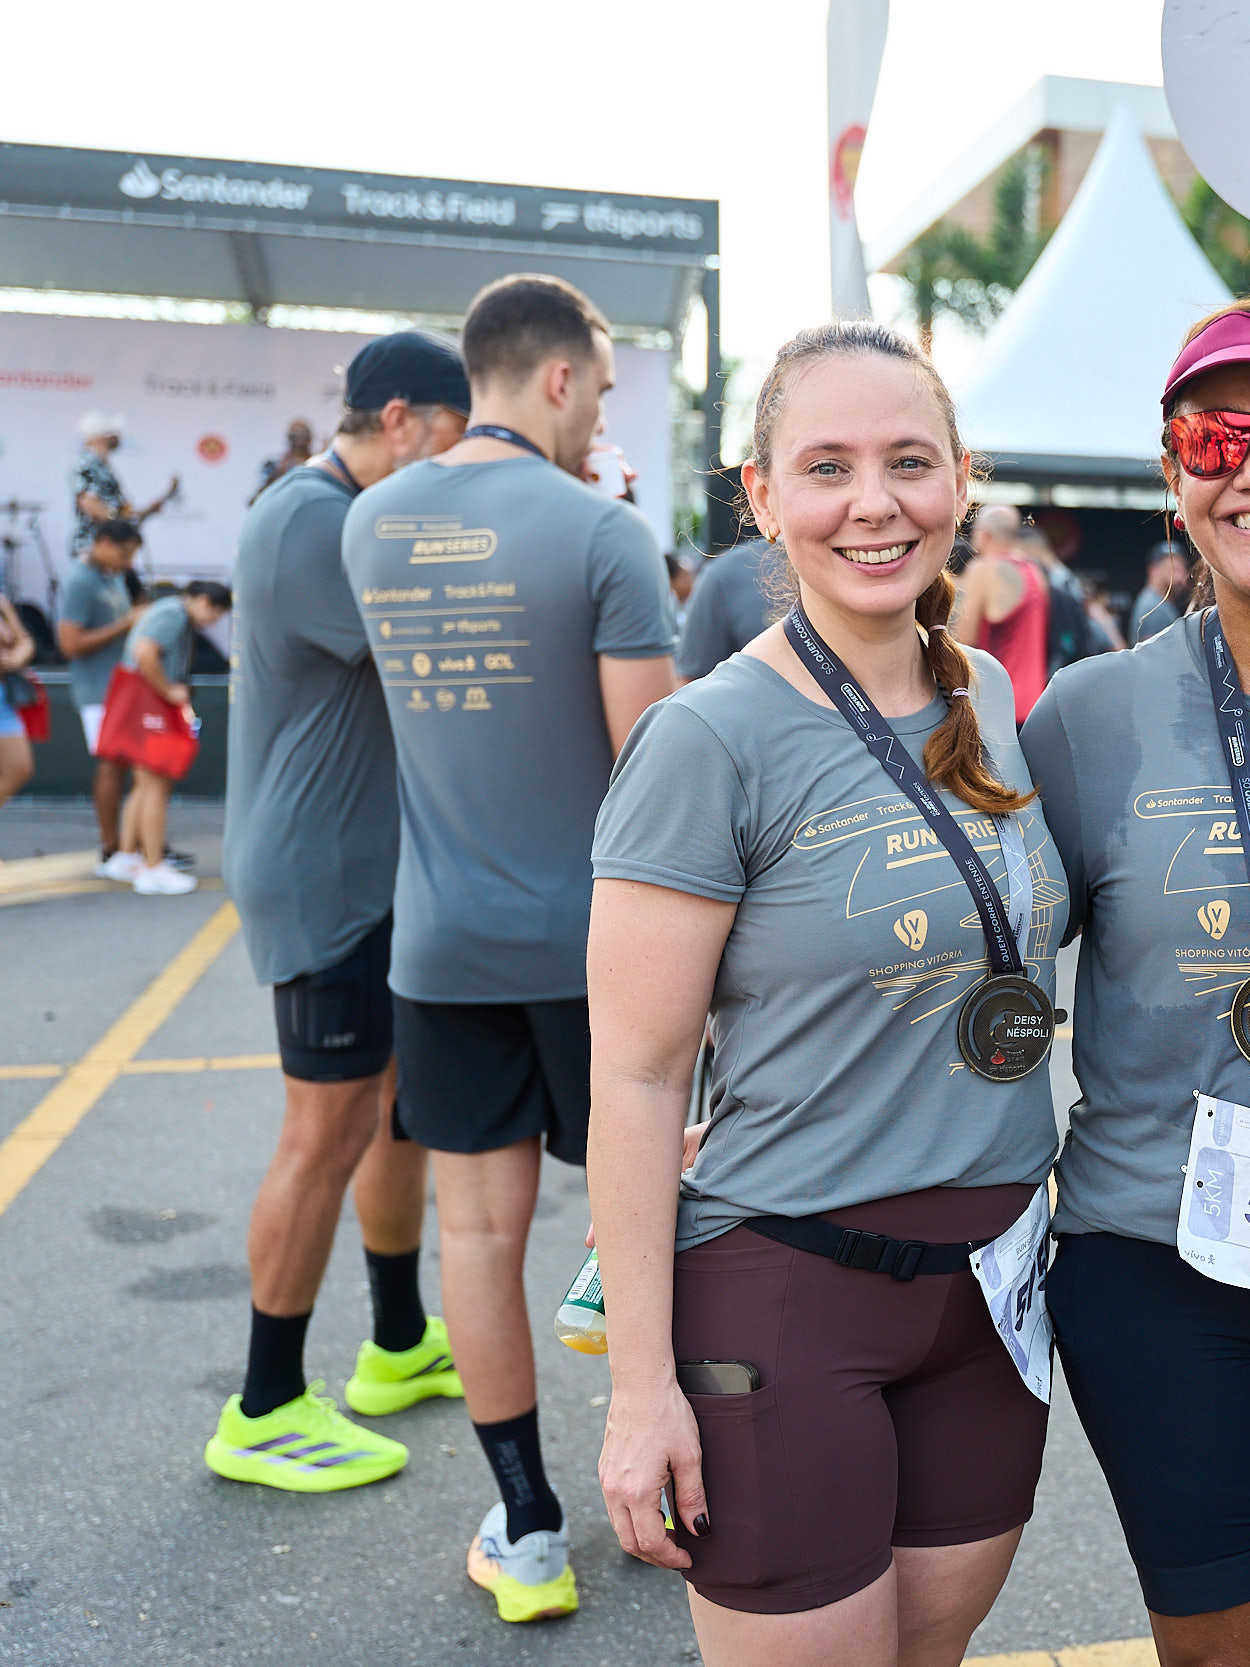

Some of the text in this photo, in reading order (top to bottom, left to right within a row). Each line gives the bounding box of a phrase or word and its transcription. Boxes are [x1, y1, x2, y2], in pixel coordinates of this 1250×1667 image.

[803, 638, 825, 663] QUEM
[820, 662, 834, 675] SÓ
[1157, 796, 1205, 808] Santander
[817, 811, 869, 835] Santander
[964, 858, 990, 900] ENTENDE
[985, 901, 1001, 933] CORRE
[996, 934, 1010, 962] QUEM
[1175, 948, 1225, 959] SHOPPING
[868, 949, 963, 978] SHOPPING VITÓRIA
[1006, 1026, 1049, 1038] NÉSPOLI
[1014, 1015, 1044, 1025] DEISY
[1203, 1168, 1224, 1217] 5KM
